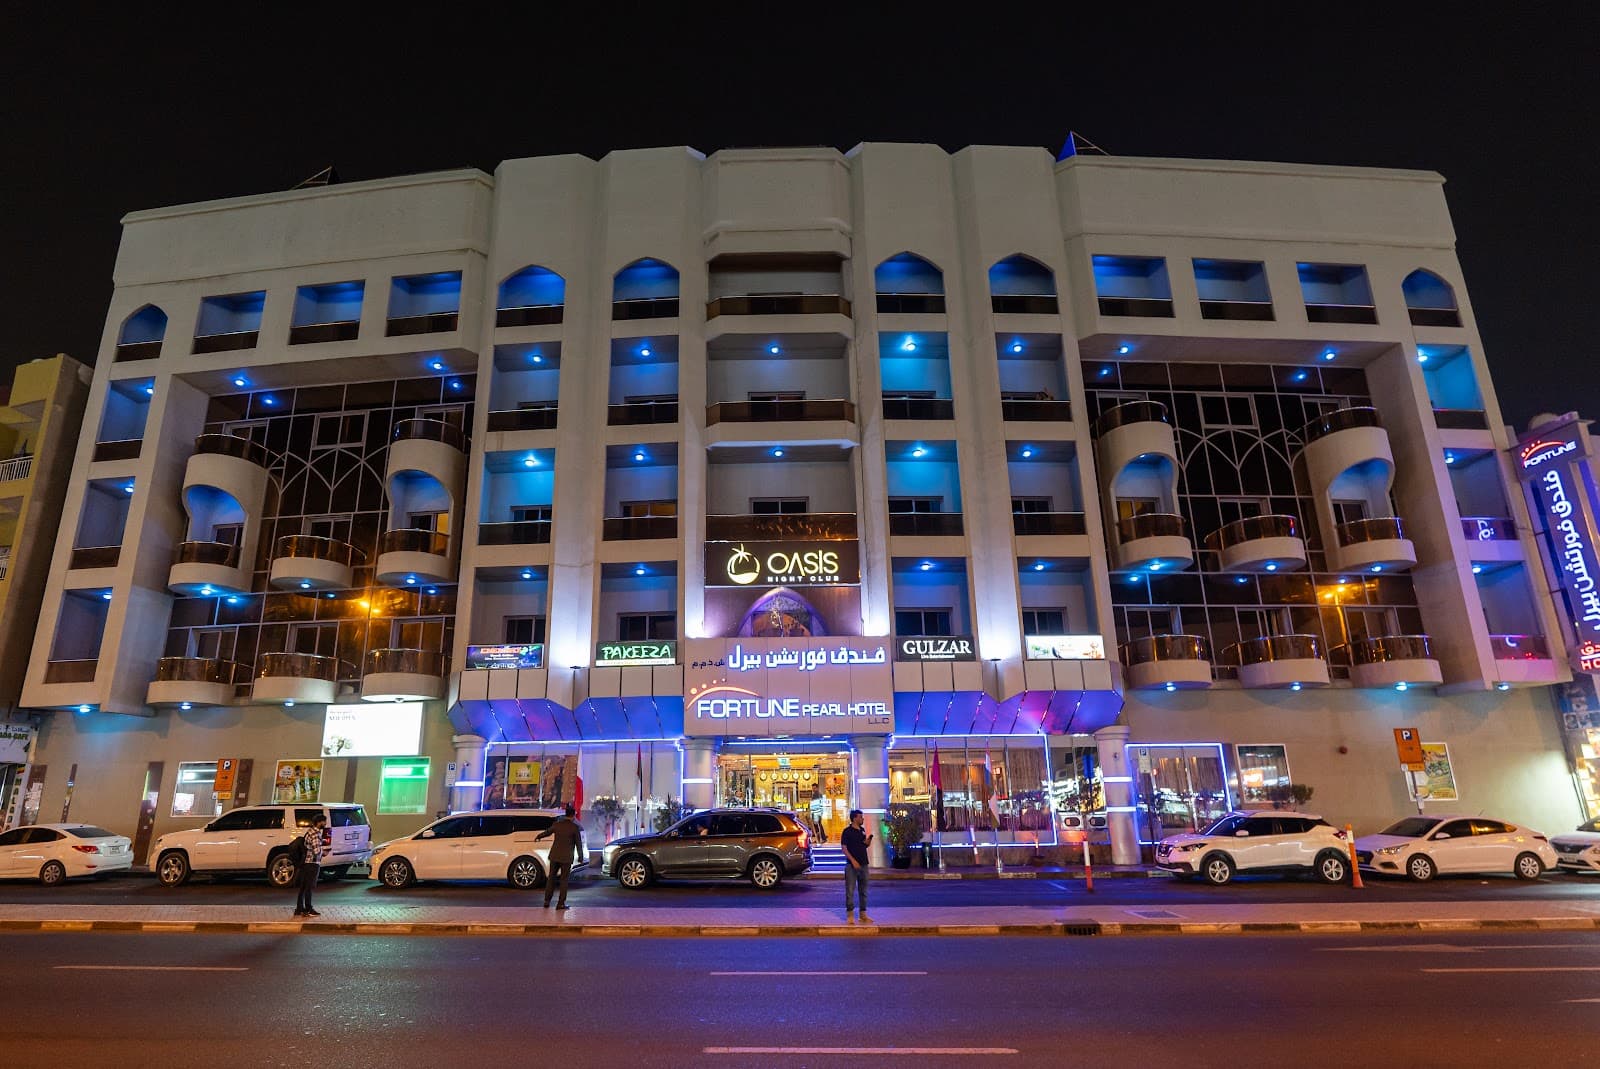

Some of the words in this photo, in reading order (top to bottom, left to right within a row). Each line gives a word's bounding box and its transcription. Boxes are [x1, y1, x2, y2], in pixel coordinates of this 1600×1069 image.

[1523, 441, 1577, 468] FORTUNE
[1543, 470, 1572, 518] فندق
[767, 549, 839, 576] OASIS
[1557, 519, 1594, 592] فورتشن
[601, 645, 671, 659] PAKEEZA
[830, 646, 886, 664] فندق
[903, 640, 972, 654] GULZAR
[728, 645, 761, 671] بيرل
[765, 647, 826, 671] فورتشن
[697, 698, 799, 718] FORTUNE
[802, 703, 846, 717] PEARL
[847, 702, 891, 716] HOTEL
[868, 717, 890, 725] LLC
[1402, 730, 1411, 740] P
[223, 760, 231, 769] P
